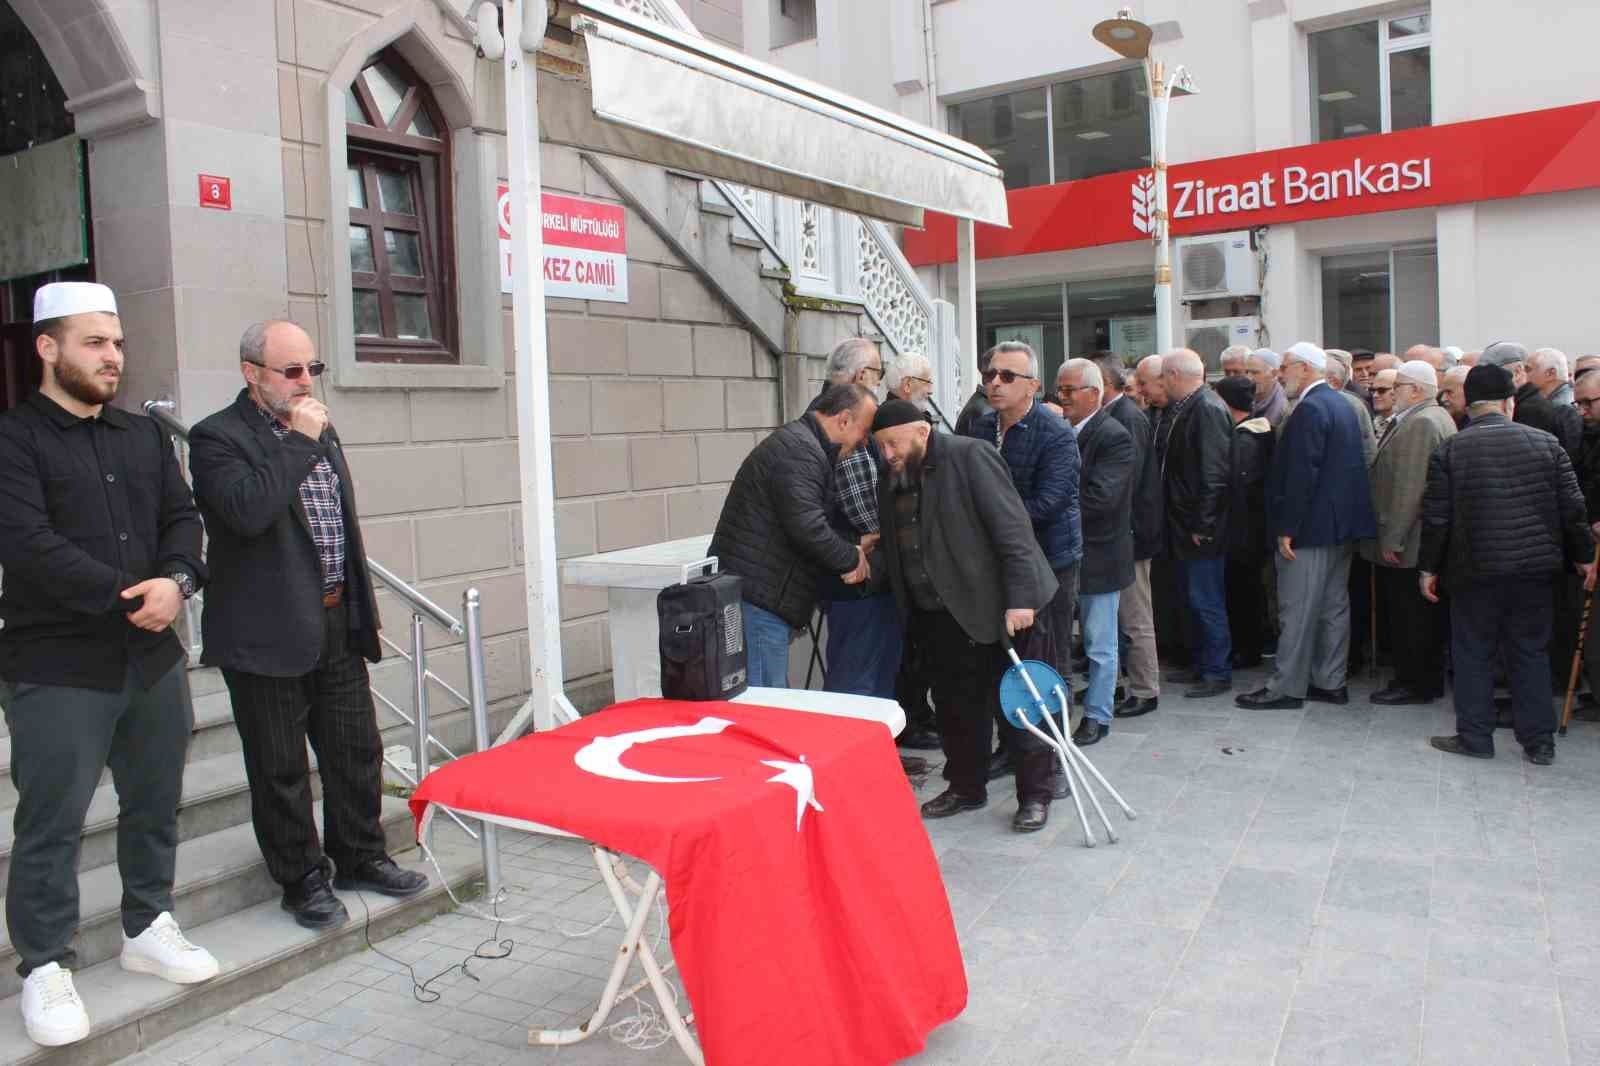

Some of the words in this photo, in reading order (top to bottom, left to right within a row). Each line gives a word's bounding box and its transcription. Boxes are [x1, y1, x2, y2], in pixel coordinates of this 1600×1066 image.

[1173, 172, 1276, 218] Ziraat
[1283, 158, 1431, 205] Bankası
[543, 212, 568, 232] RKELİ
[570, 215, 619, 239] MÜFTÜLÜĞÜ
[575, 258, 615, 286] CAMİİ
